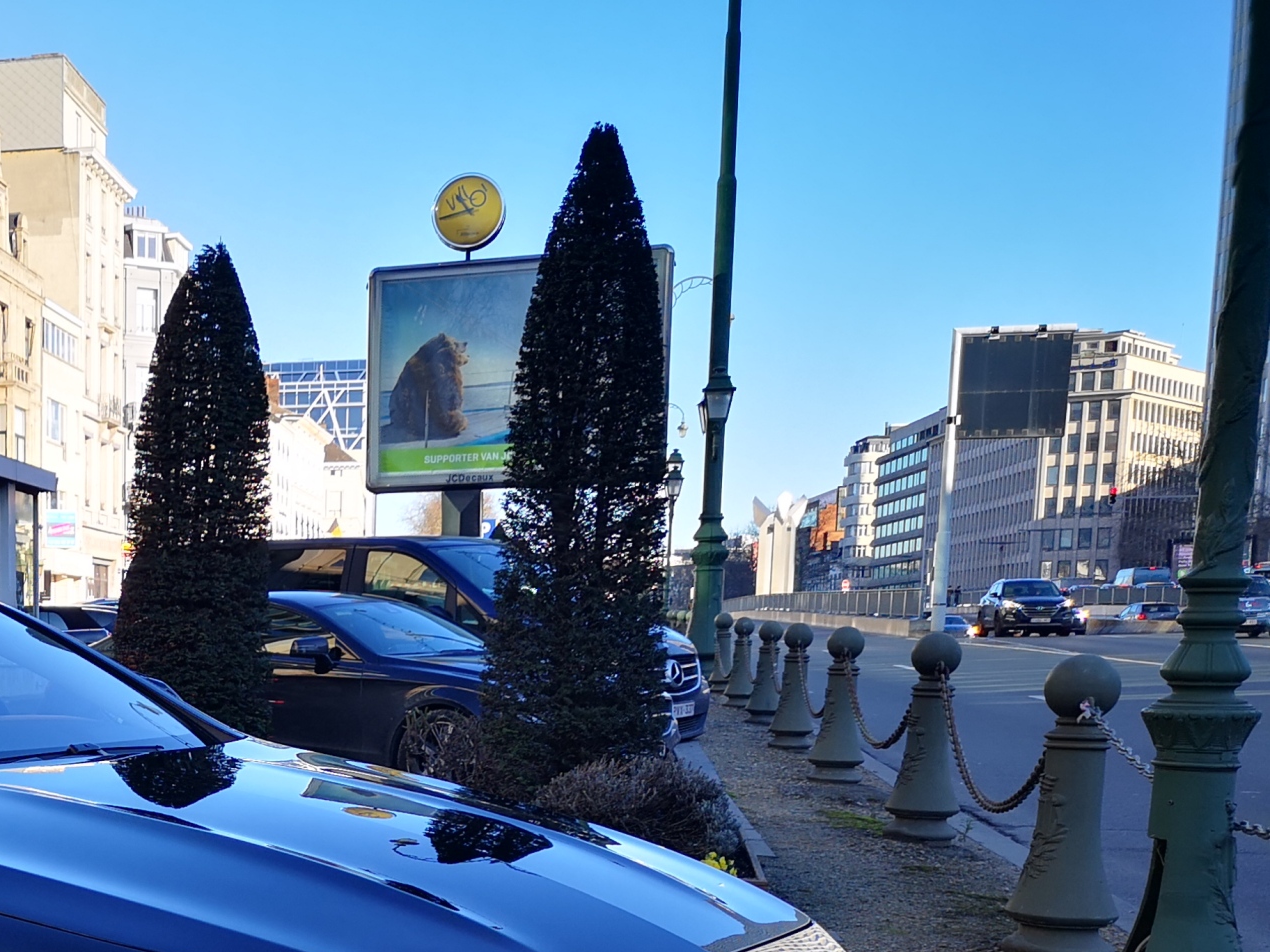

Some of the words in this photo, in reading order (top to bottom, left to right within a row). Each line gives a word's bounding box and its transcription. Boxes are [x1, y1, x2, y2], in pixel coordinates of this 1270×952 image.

[423, 453, 479, 464] SUPPORTER
[480, 452, 499, 461] VAN
[446, 474, 494, 483] JCDecaux
